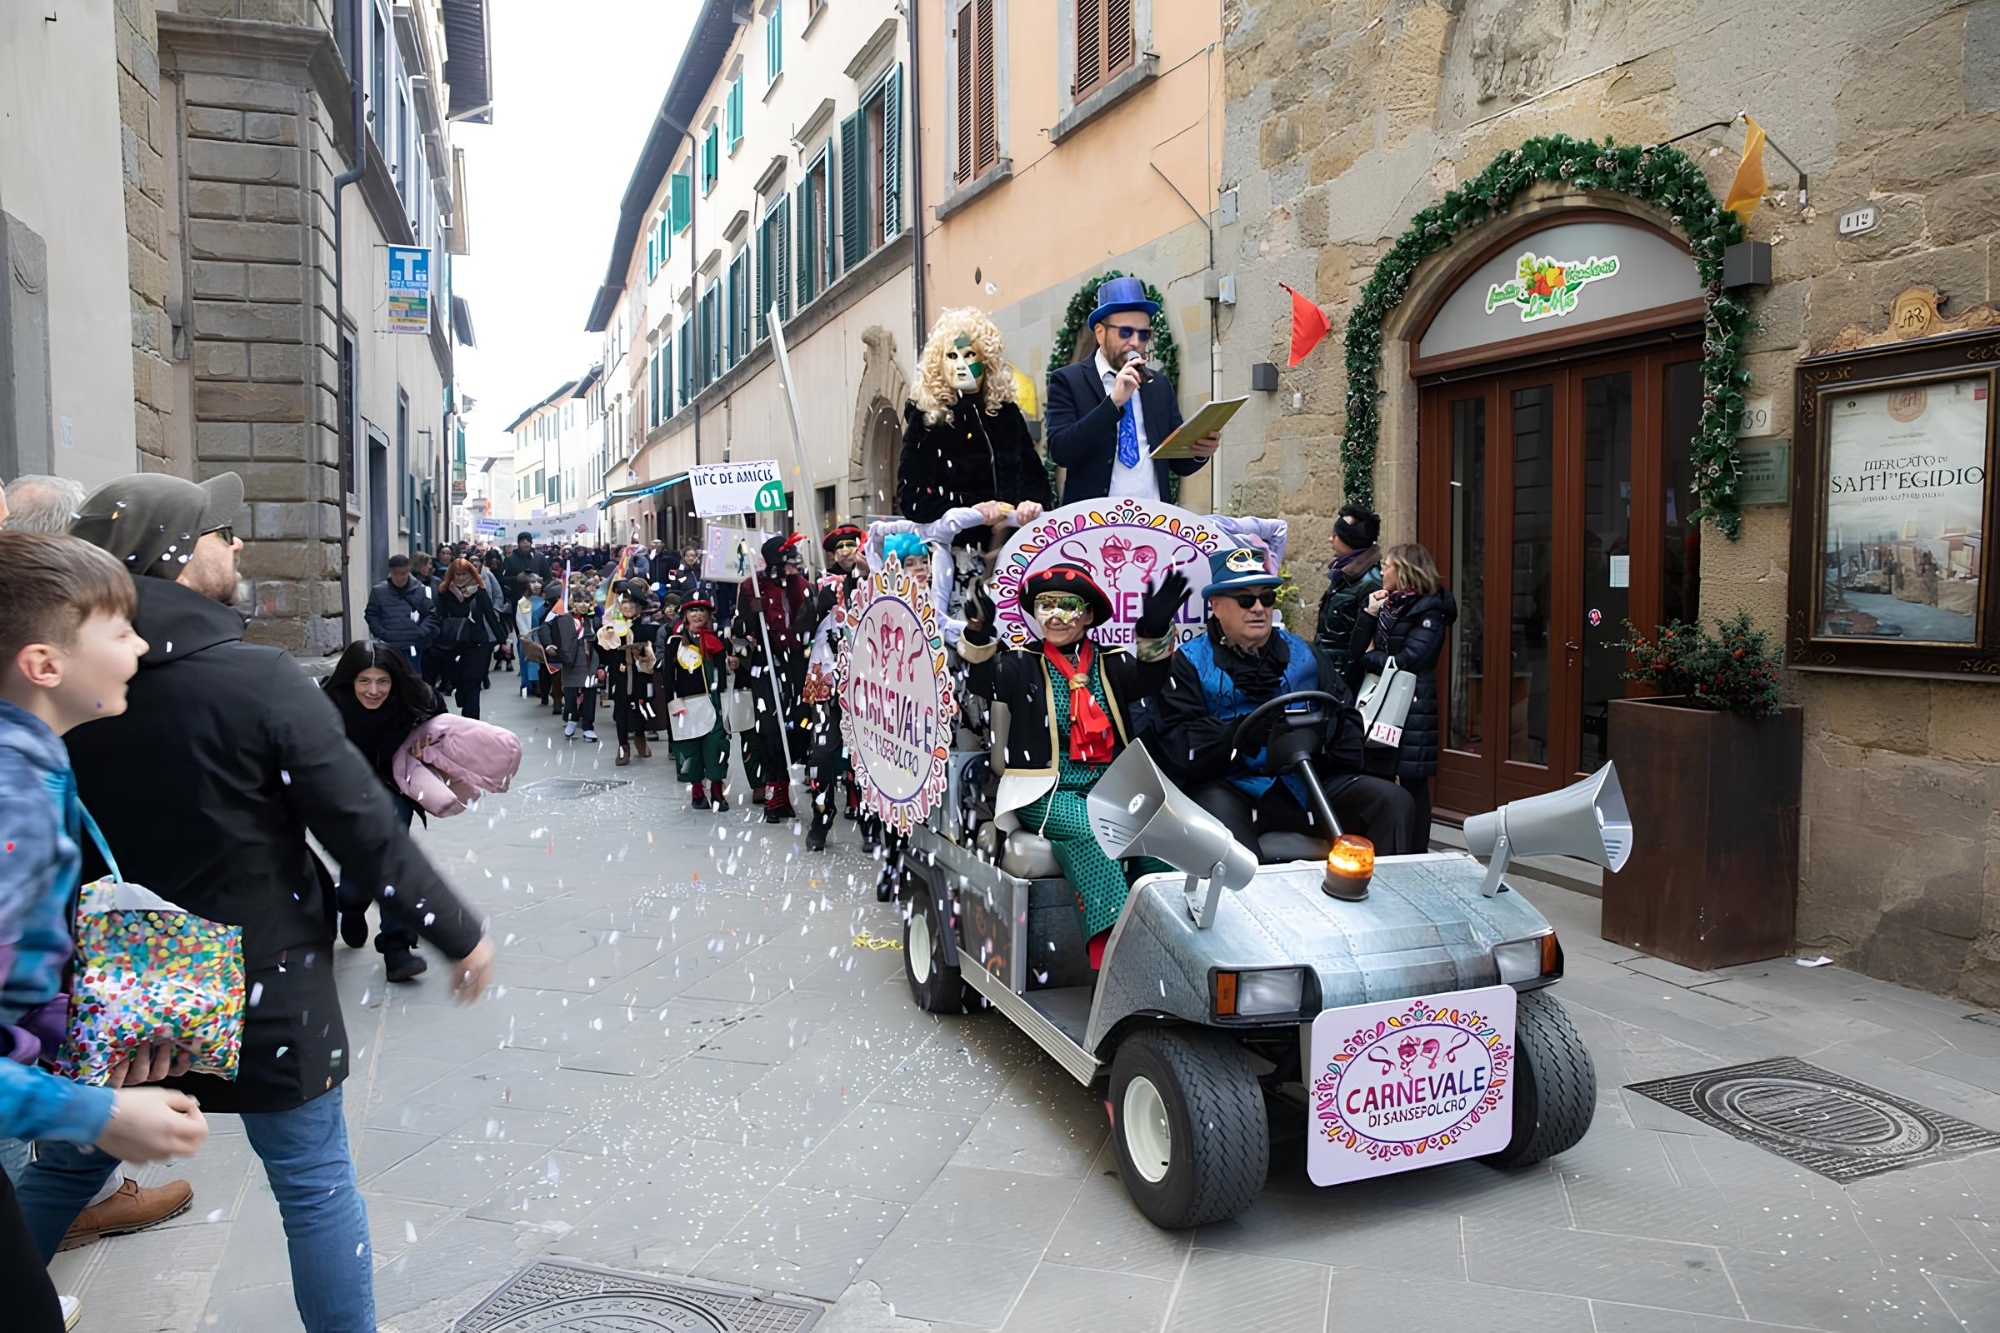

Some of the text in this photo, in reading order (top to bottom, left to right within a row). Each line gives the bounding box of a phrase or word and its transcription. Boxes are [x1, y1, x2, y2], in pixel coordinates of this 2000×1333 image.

[395, 251, 422, 281] T
[720, 472, 733, 484] DE
[760, 490, 781, 508] 01
[1346, 1066, 1486, 1115] CARNEVALE
[1368, 1096, 1467, 1128] DI SANSEPOLCRO
